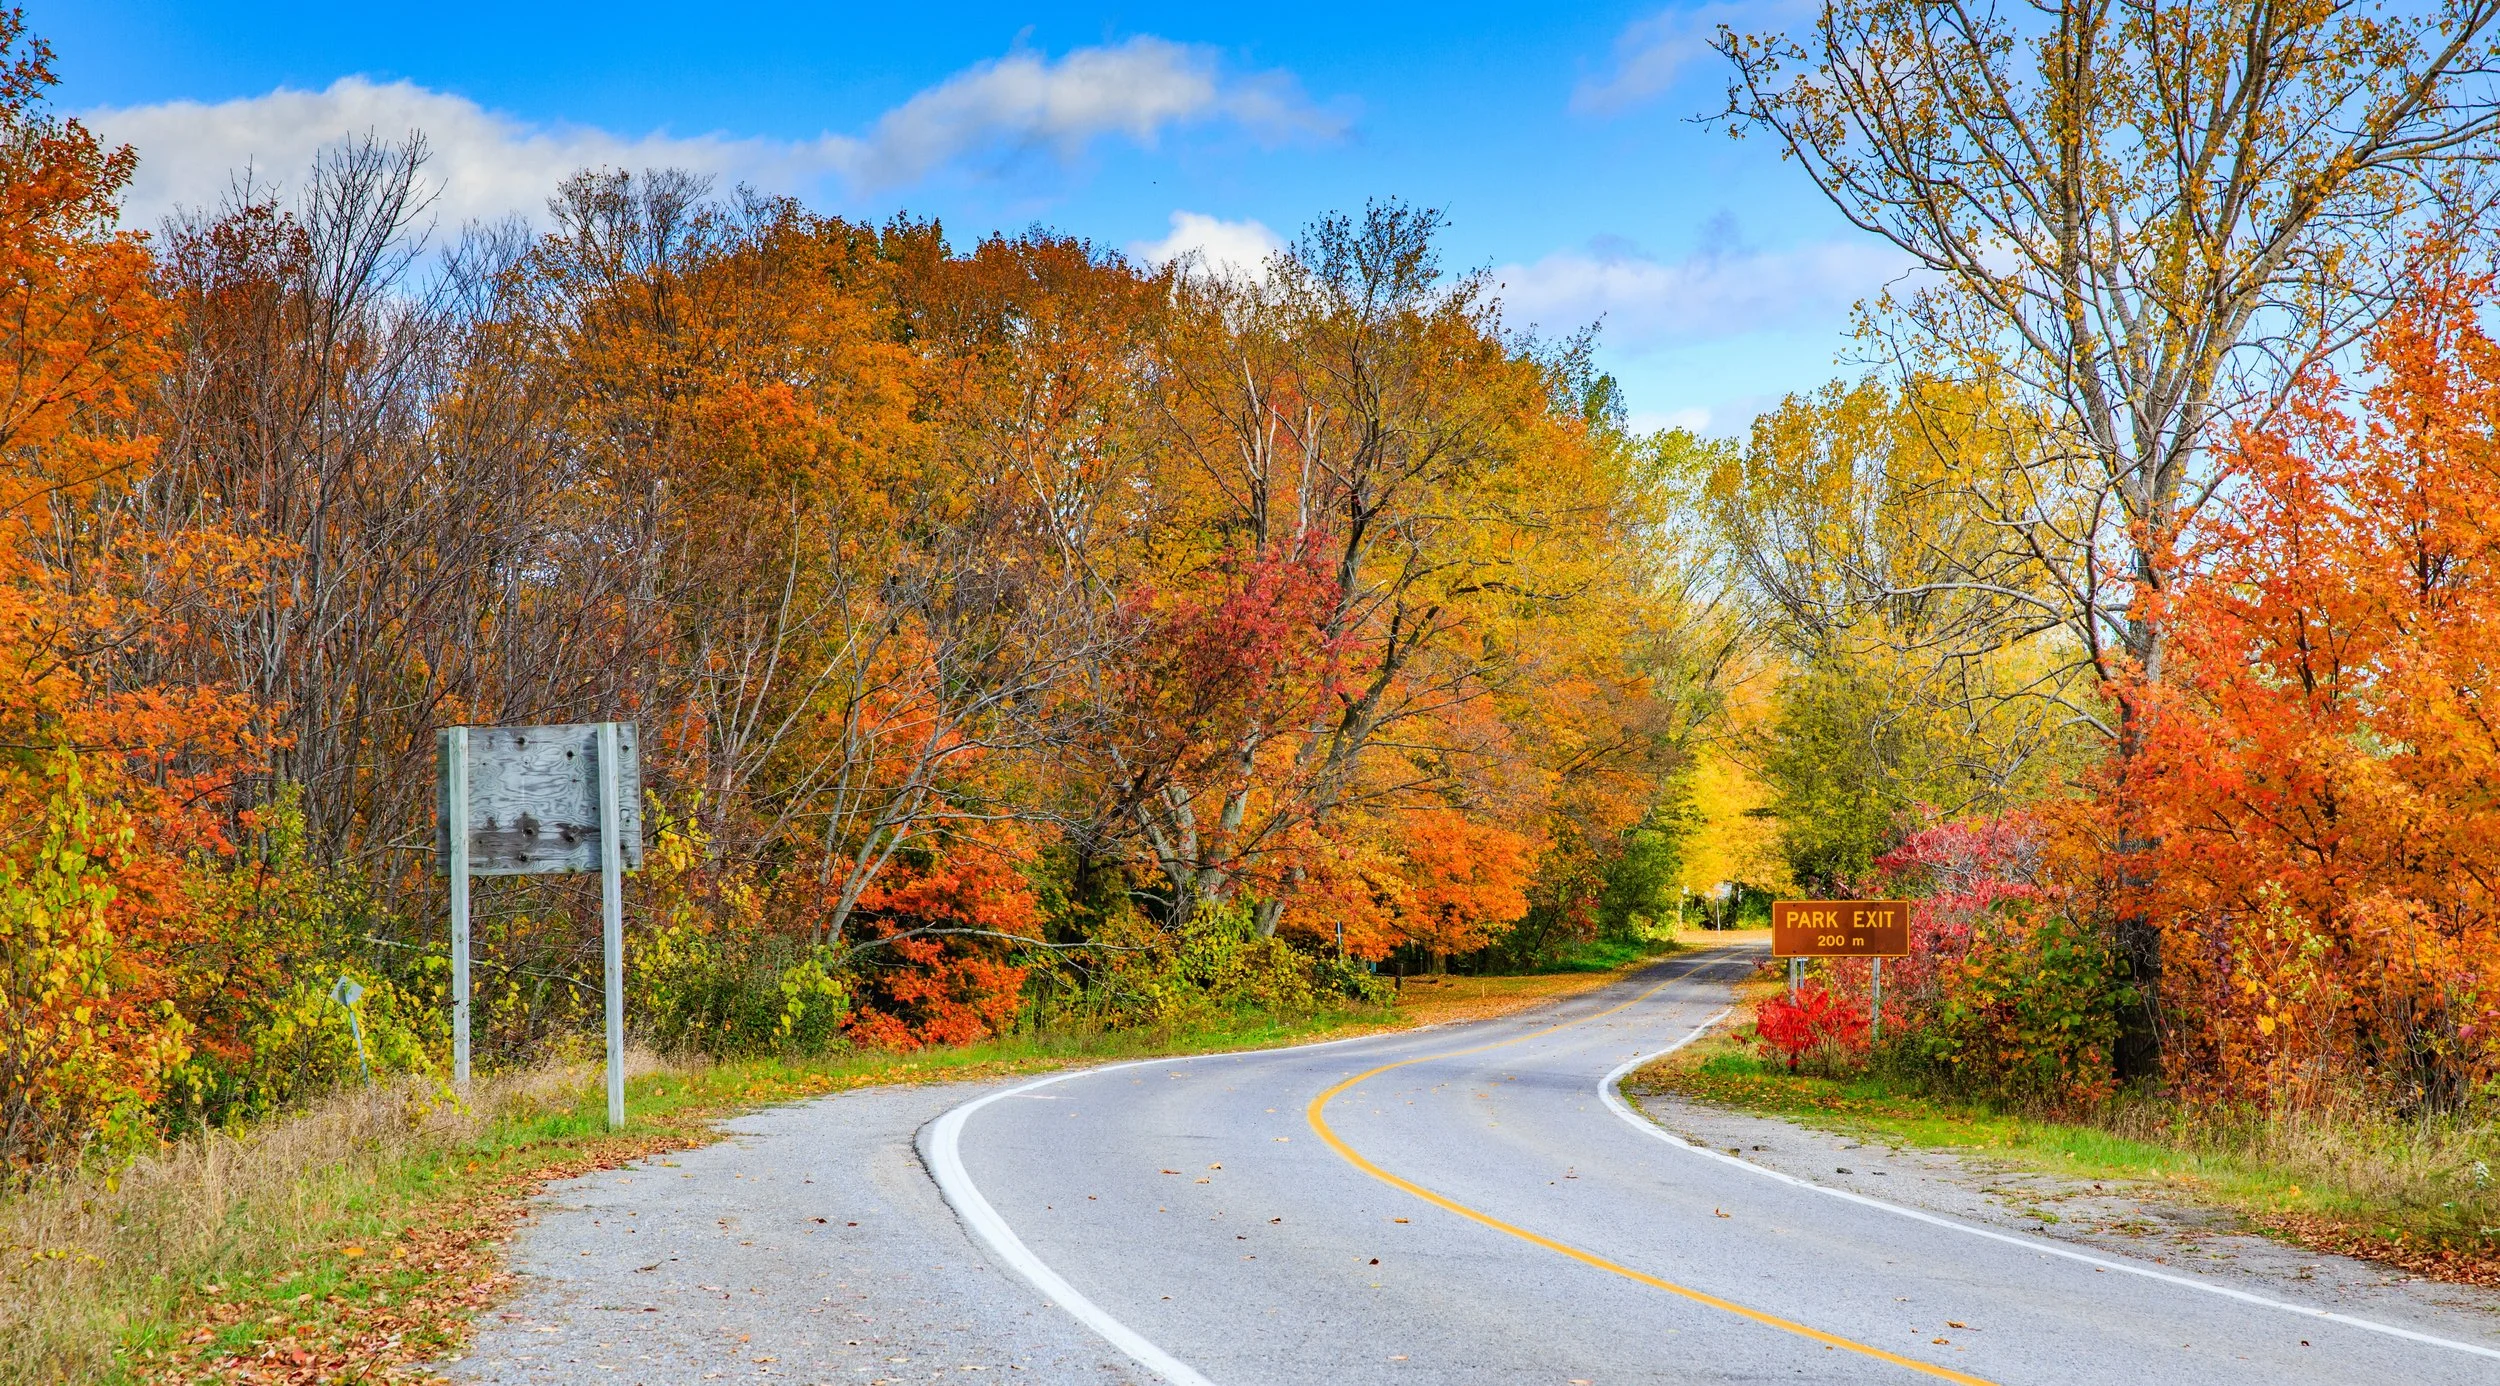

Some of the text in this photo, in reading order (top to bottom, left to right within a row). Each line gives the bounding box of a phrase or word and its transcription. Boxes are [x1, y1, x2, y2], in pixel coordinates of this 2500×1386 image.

[1786, 911, 1895, 928] PARK EXIT
[1817, 935, 1865, 947] 200 m
